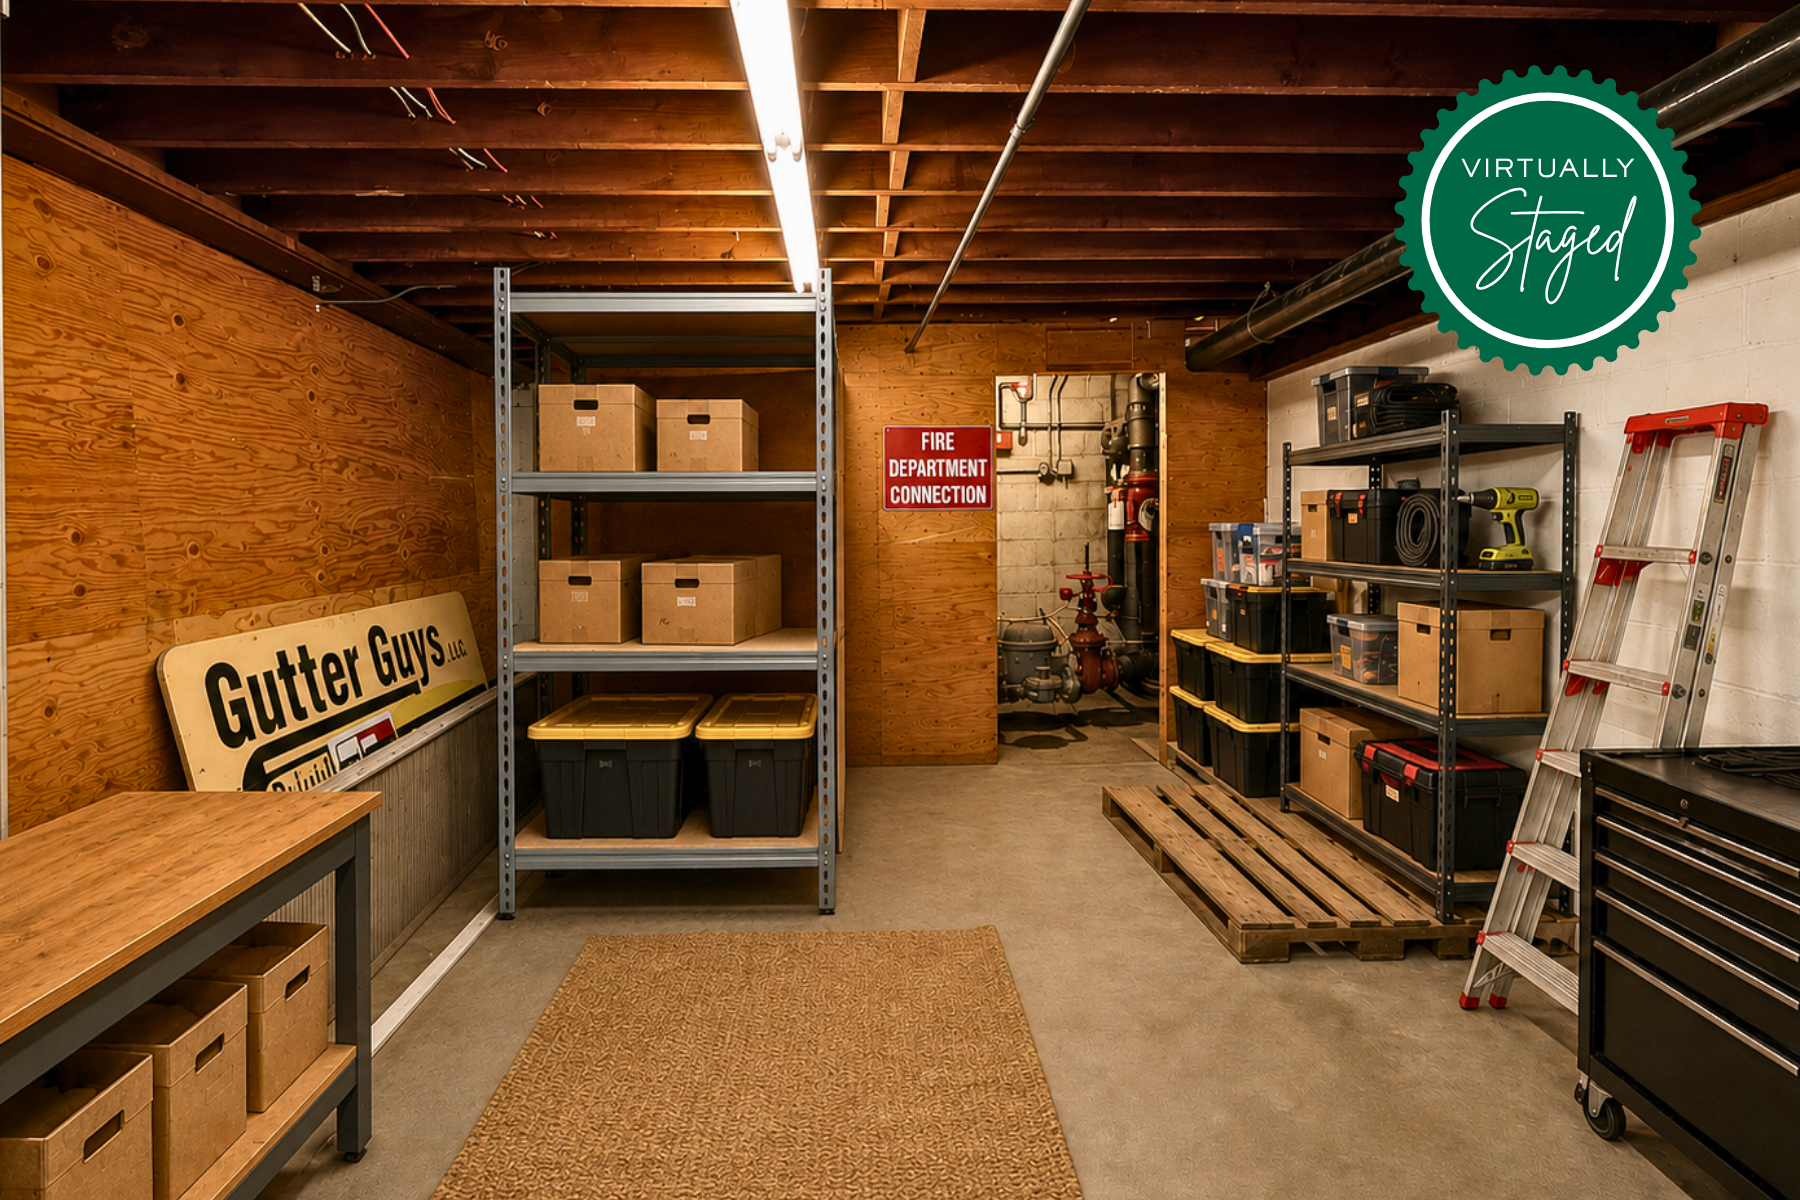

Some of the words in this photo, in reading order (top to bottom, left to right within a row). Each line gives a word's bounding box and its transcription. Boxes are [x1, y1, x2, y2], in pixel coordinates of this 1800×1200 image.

[921, 431, 955, 451] FIRE
[889, 458, 988, 478] DEPARTMENT
[890, 485, 987, 505] CONNECTION
[204, 644, 363, 749] Gutter
[367, 624, 446, 687] Guys
